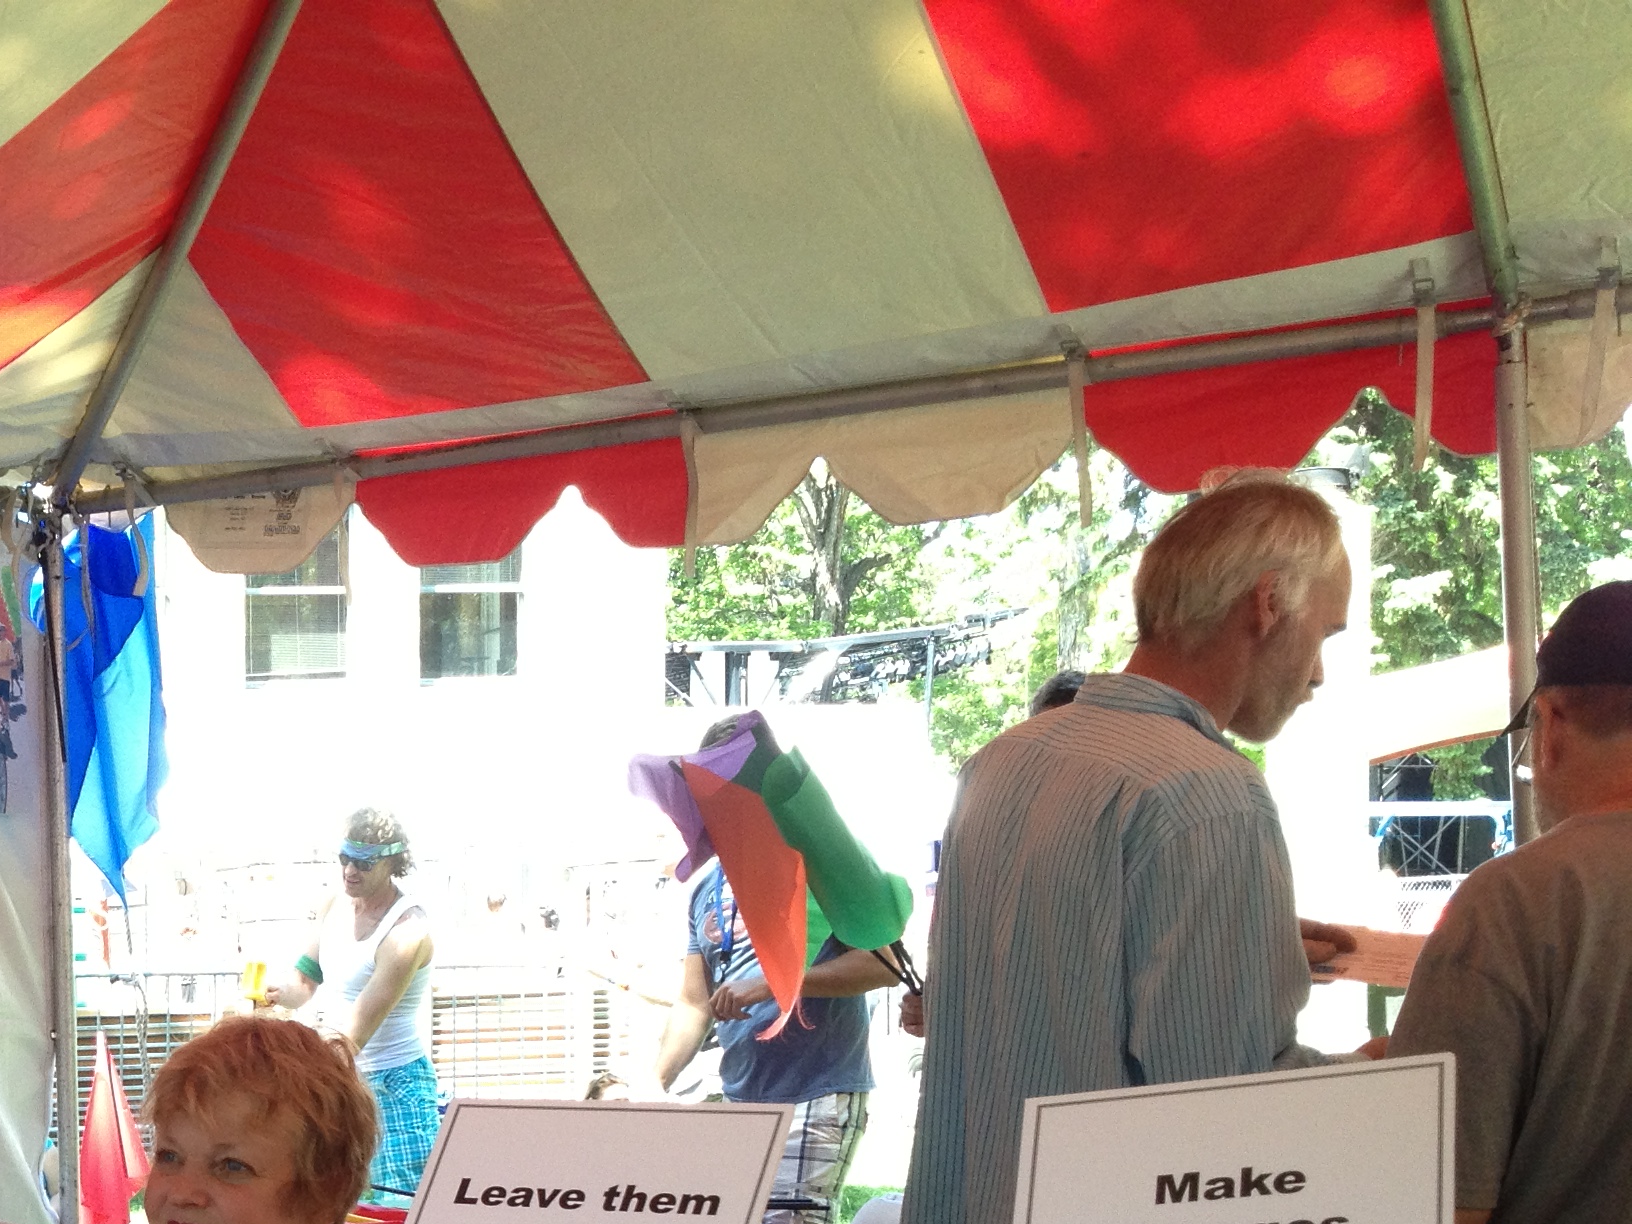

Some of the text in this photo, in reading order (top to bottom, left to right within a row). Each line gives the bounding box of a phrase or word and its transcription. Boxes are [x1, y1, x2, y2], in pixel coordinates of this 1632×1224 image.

[454, 1178, 720, 1215] Leave them
[1154, 1167, 1306, 1204] Make
